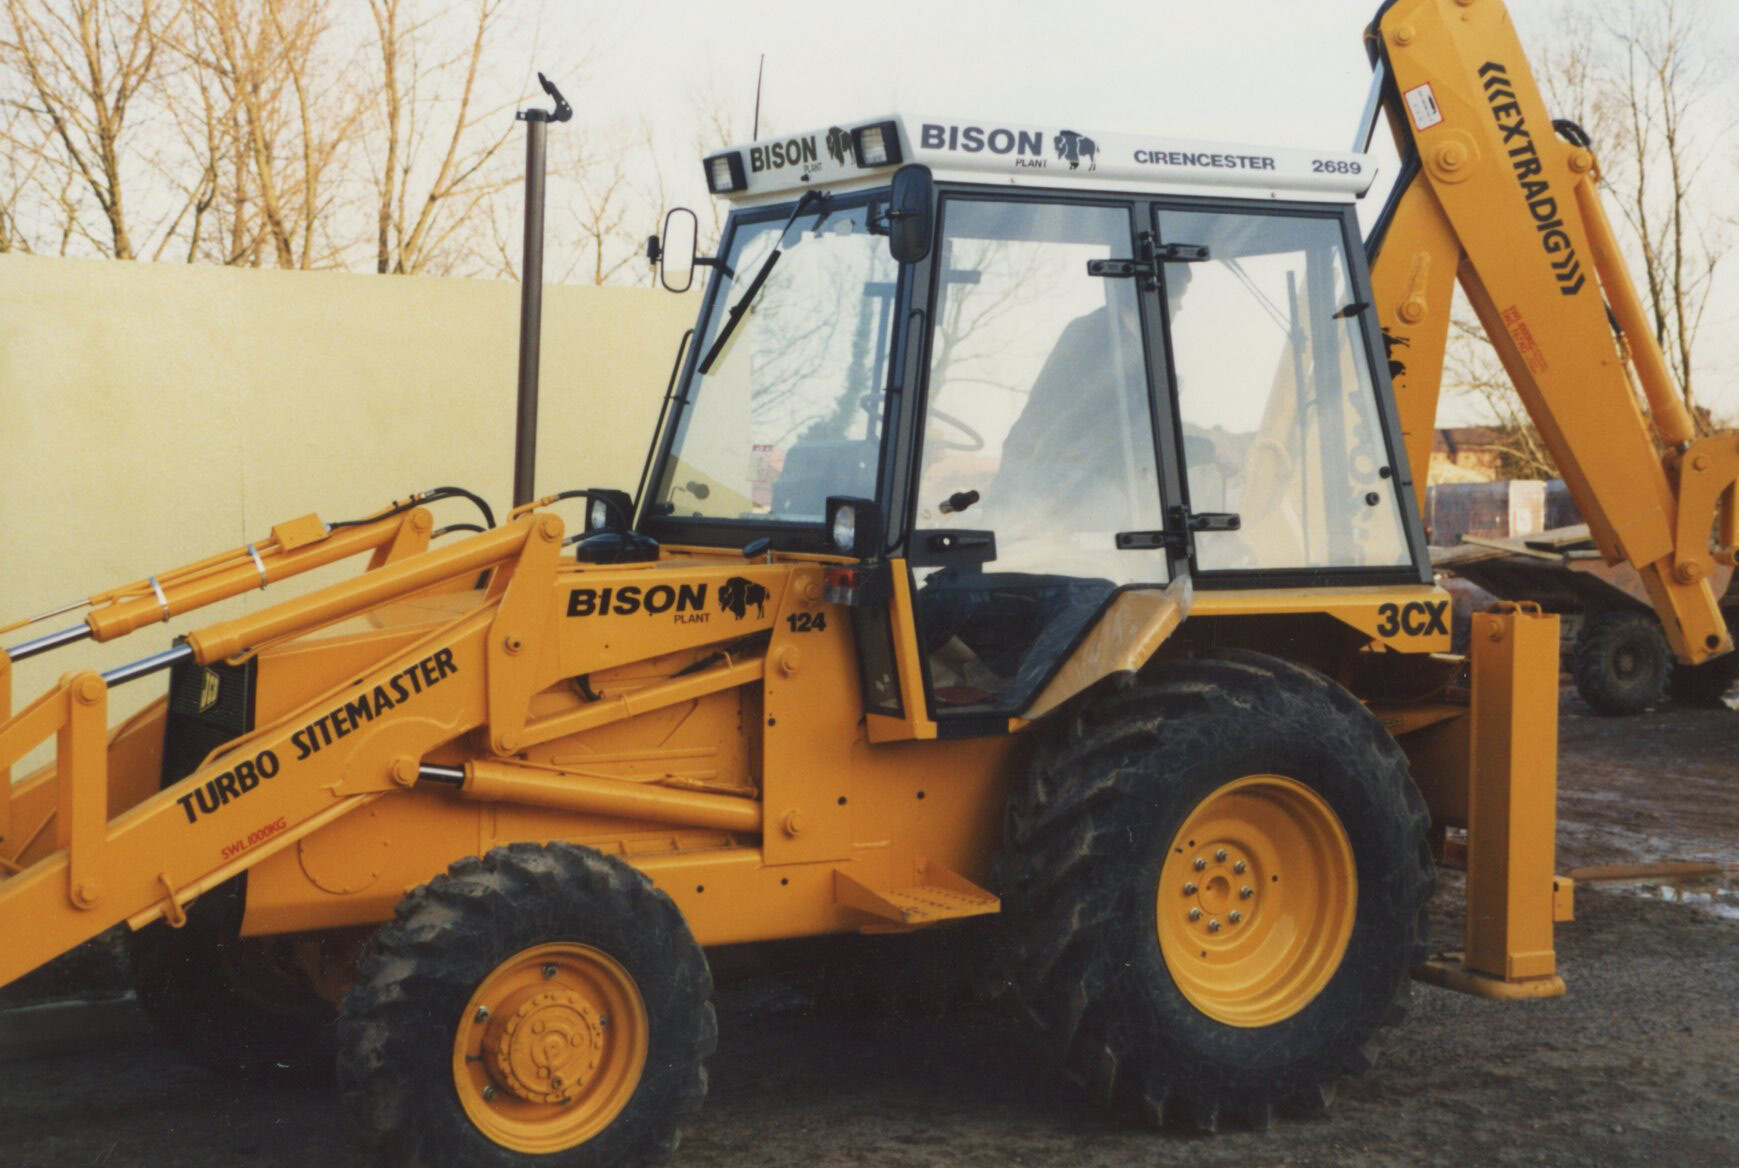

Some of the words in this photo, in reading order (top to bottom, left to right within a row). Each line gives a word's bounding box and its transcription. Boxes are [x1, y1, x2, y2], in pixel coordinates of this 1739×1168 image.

[750, 136, 818, 173] BISON
[921, 124, 1043, 156] BISON
[804, 162, 822, 173] PLANT
[1015, 158, 1047, 168] PLANT
[1133, 150, 1275, 170] CIRENCESTER
[1311, 160, 1362, 175] 2689
[1492, 101, 1571, 254] EXTRADIG
[566, 583, 707, 617] BISON
[674, 613, 710, 624] PLANT
[786, 612, 826, 632] 124
[1377, 601, 1449, 638] 3CX
[176, 750, 280, 824] TURBO
[291, 647, 458, 761] SITEMASTER
[222, 840, 247, 860] SWL
[247, 816, 287, 846] 1000KG
